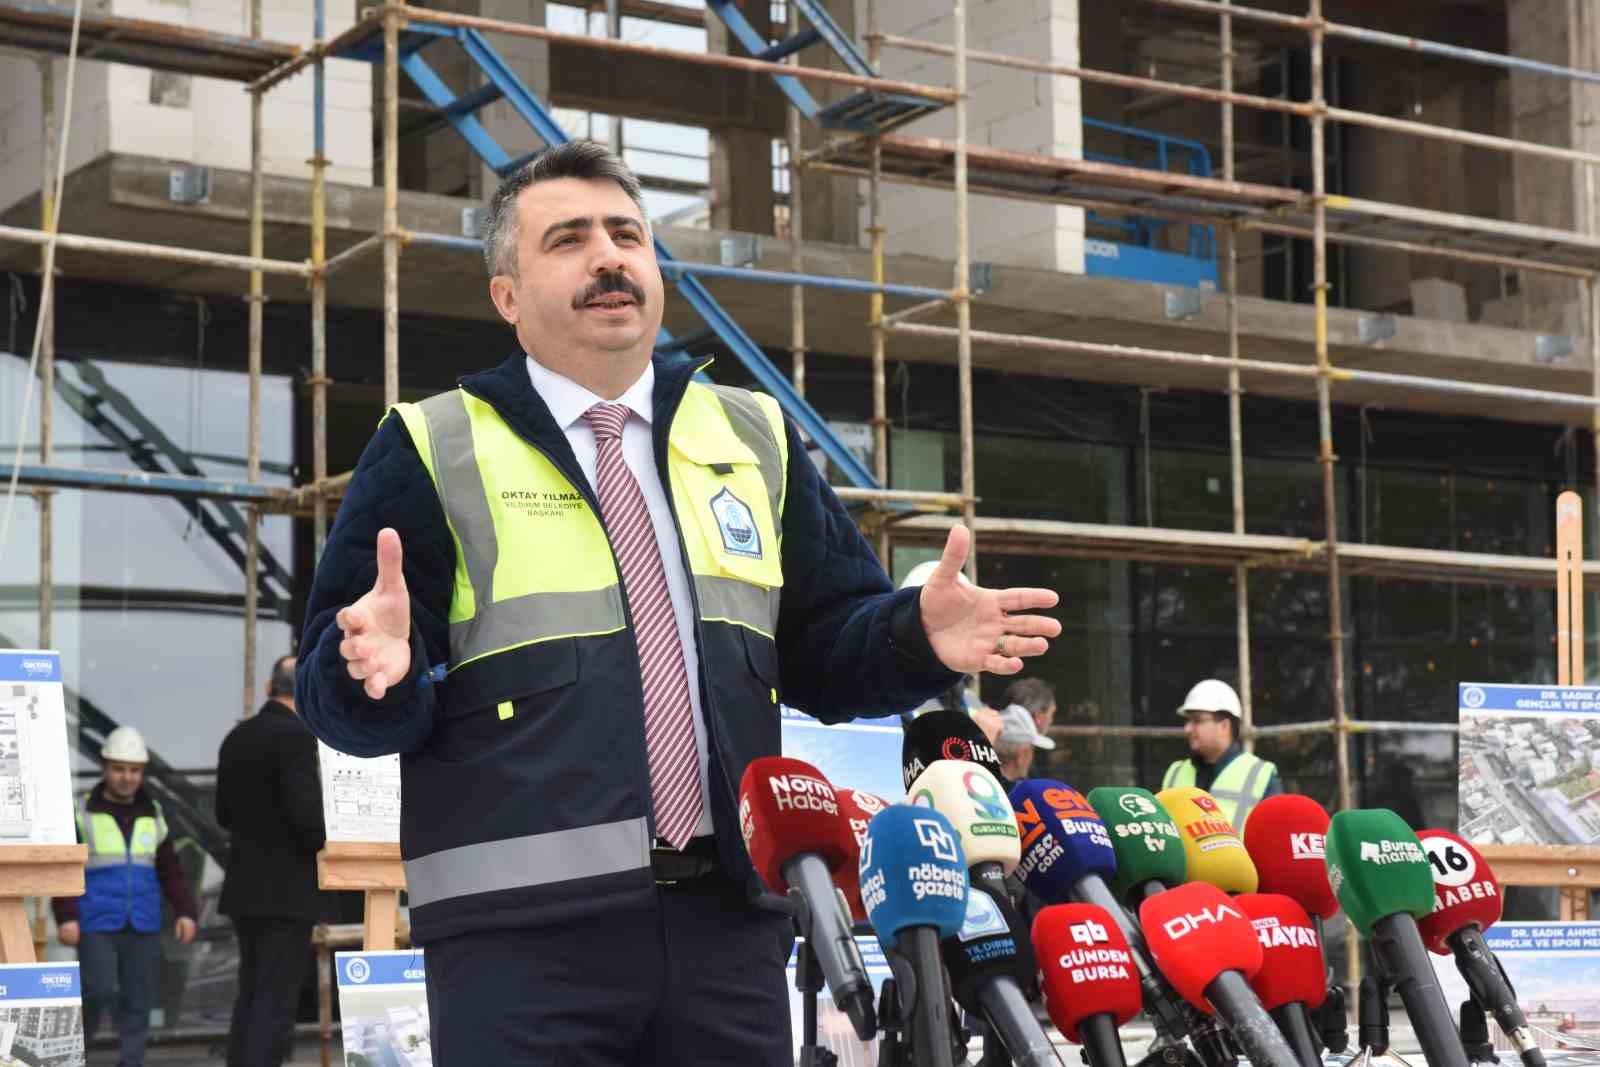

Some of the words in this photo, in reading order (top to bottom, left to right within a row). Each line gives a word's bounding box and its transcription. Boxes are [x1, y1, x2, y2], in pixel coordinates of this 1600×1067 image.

[502, 491, 538, 500] OKTAY
[1564, 701, 1578, 710] VE
[769, 774, 835, 800] Norm
[776, 792, 838, 816] Haber
[1290, 833, 1326, 854] KE
[1428, 846, 1468, 876] 16
[1257, 926, 1318, 948] HAYAT
[1511, 928, 1530, 937] DR.
[1531, 928, 1564, 938] SADIK
[1535, 939, 1549, 948] VE
[1552, 939, 1580, 948] SPOR
[1071, 965, 1130, 983] BURSA
